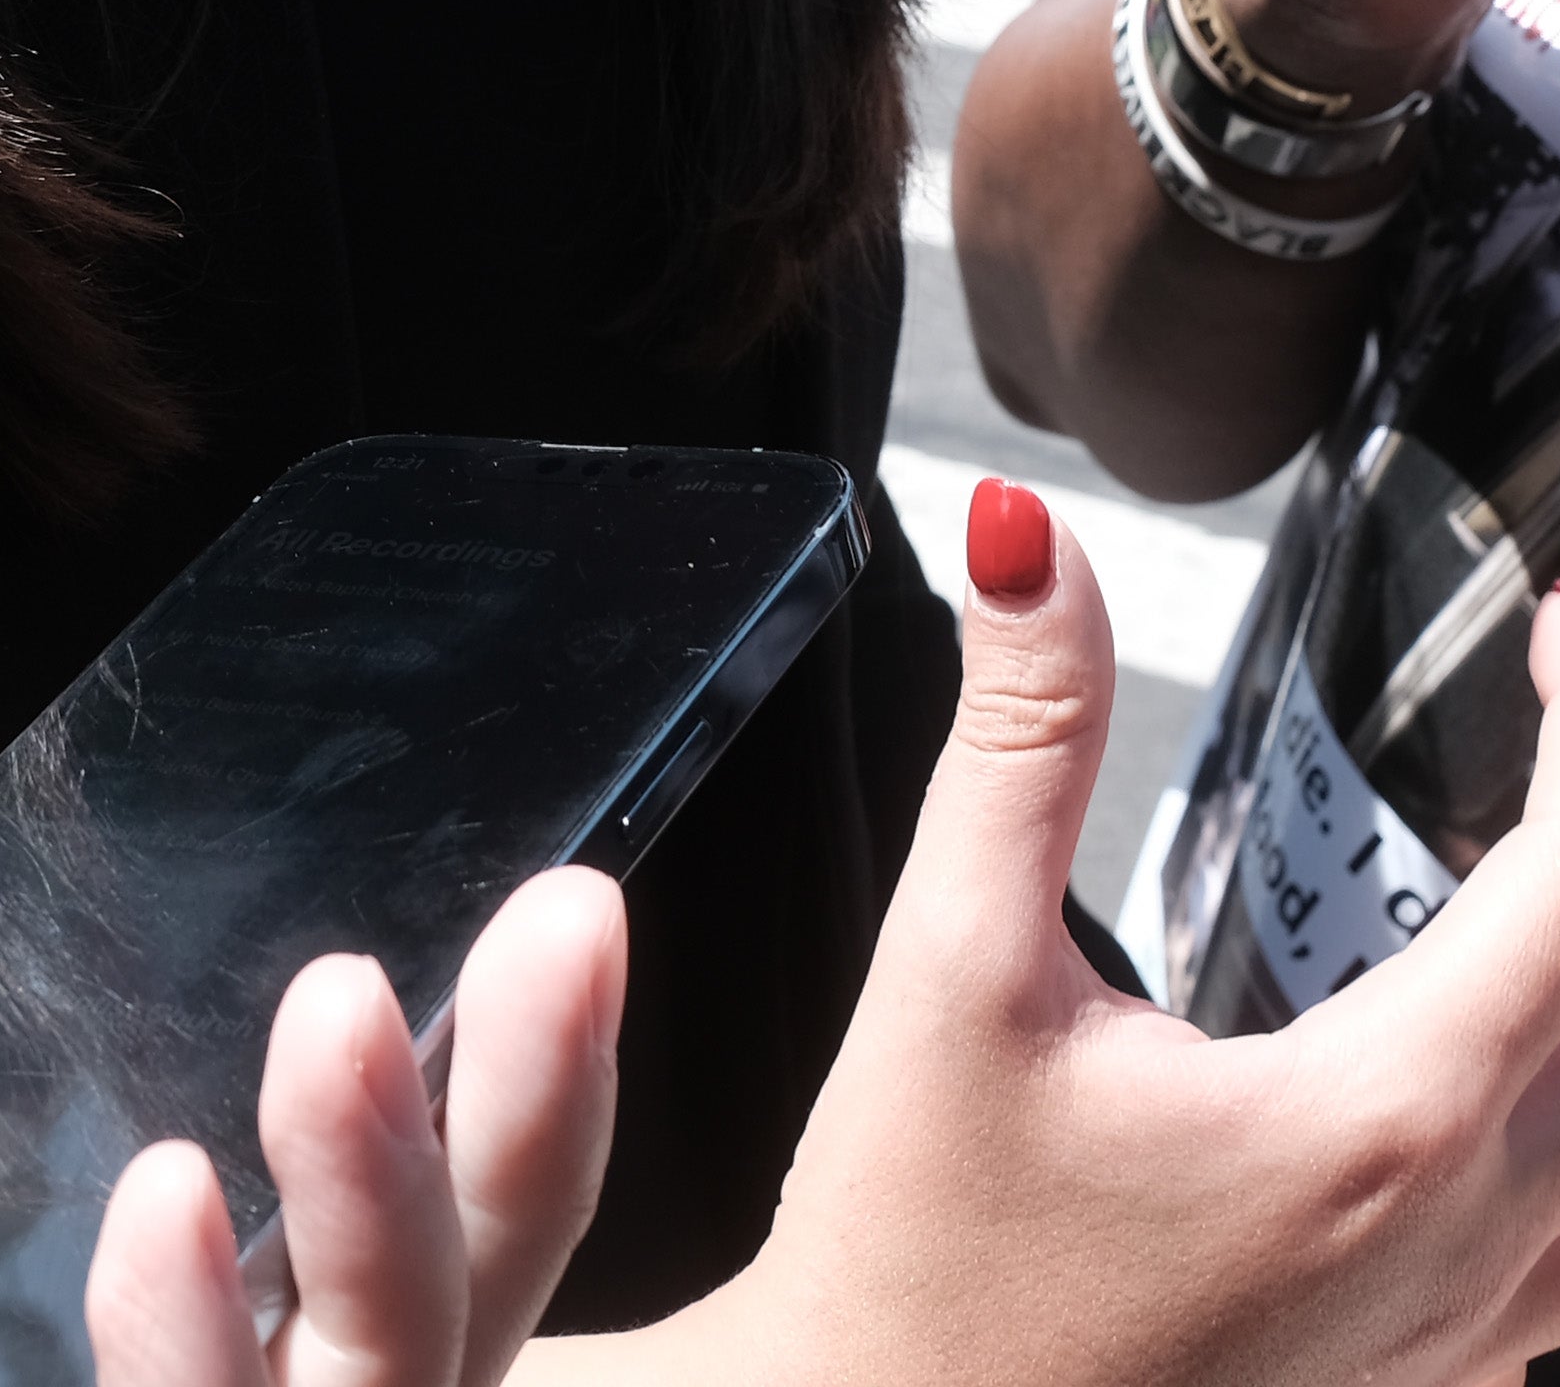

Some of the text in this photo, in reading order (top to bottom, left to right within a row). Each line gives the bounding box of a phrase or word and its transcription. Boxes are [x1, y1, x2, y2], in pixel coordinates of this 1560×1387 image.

[257, 528, 559, 571] All Recordings
[314, 580, 389, 600] Baptist
[392, 586, 473, 605] Church
